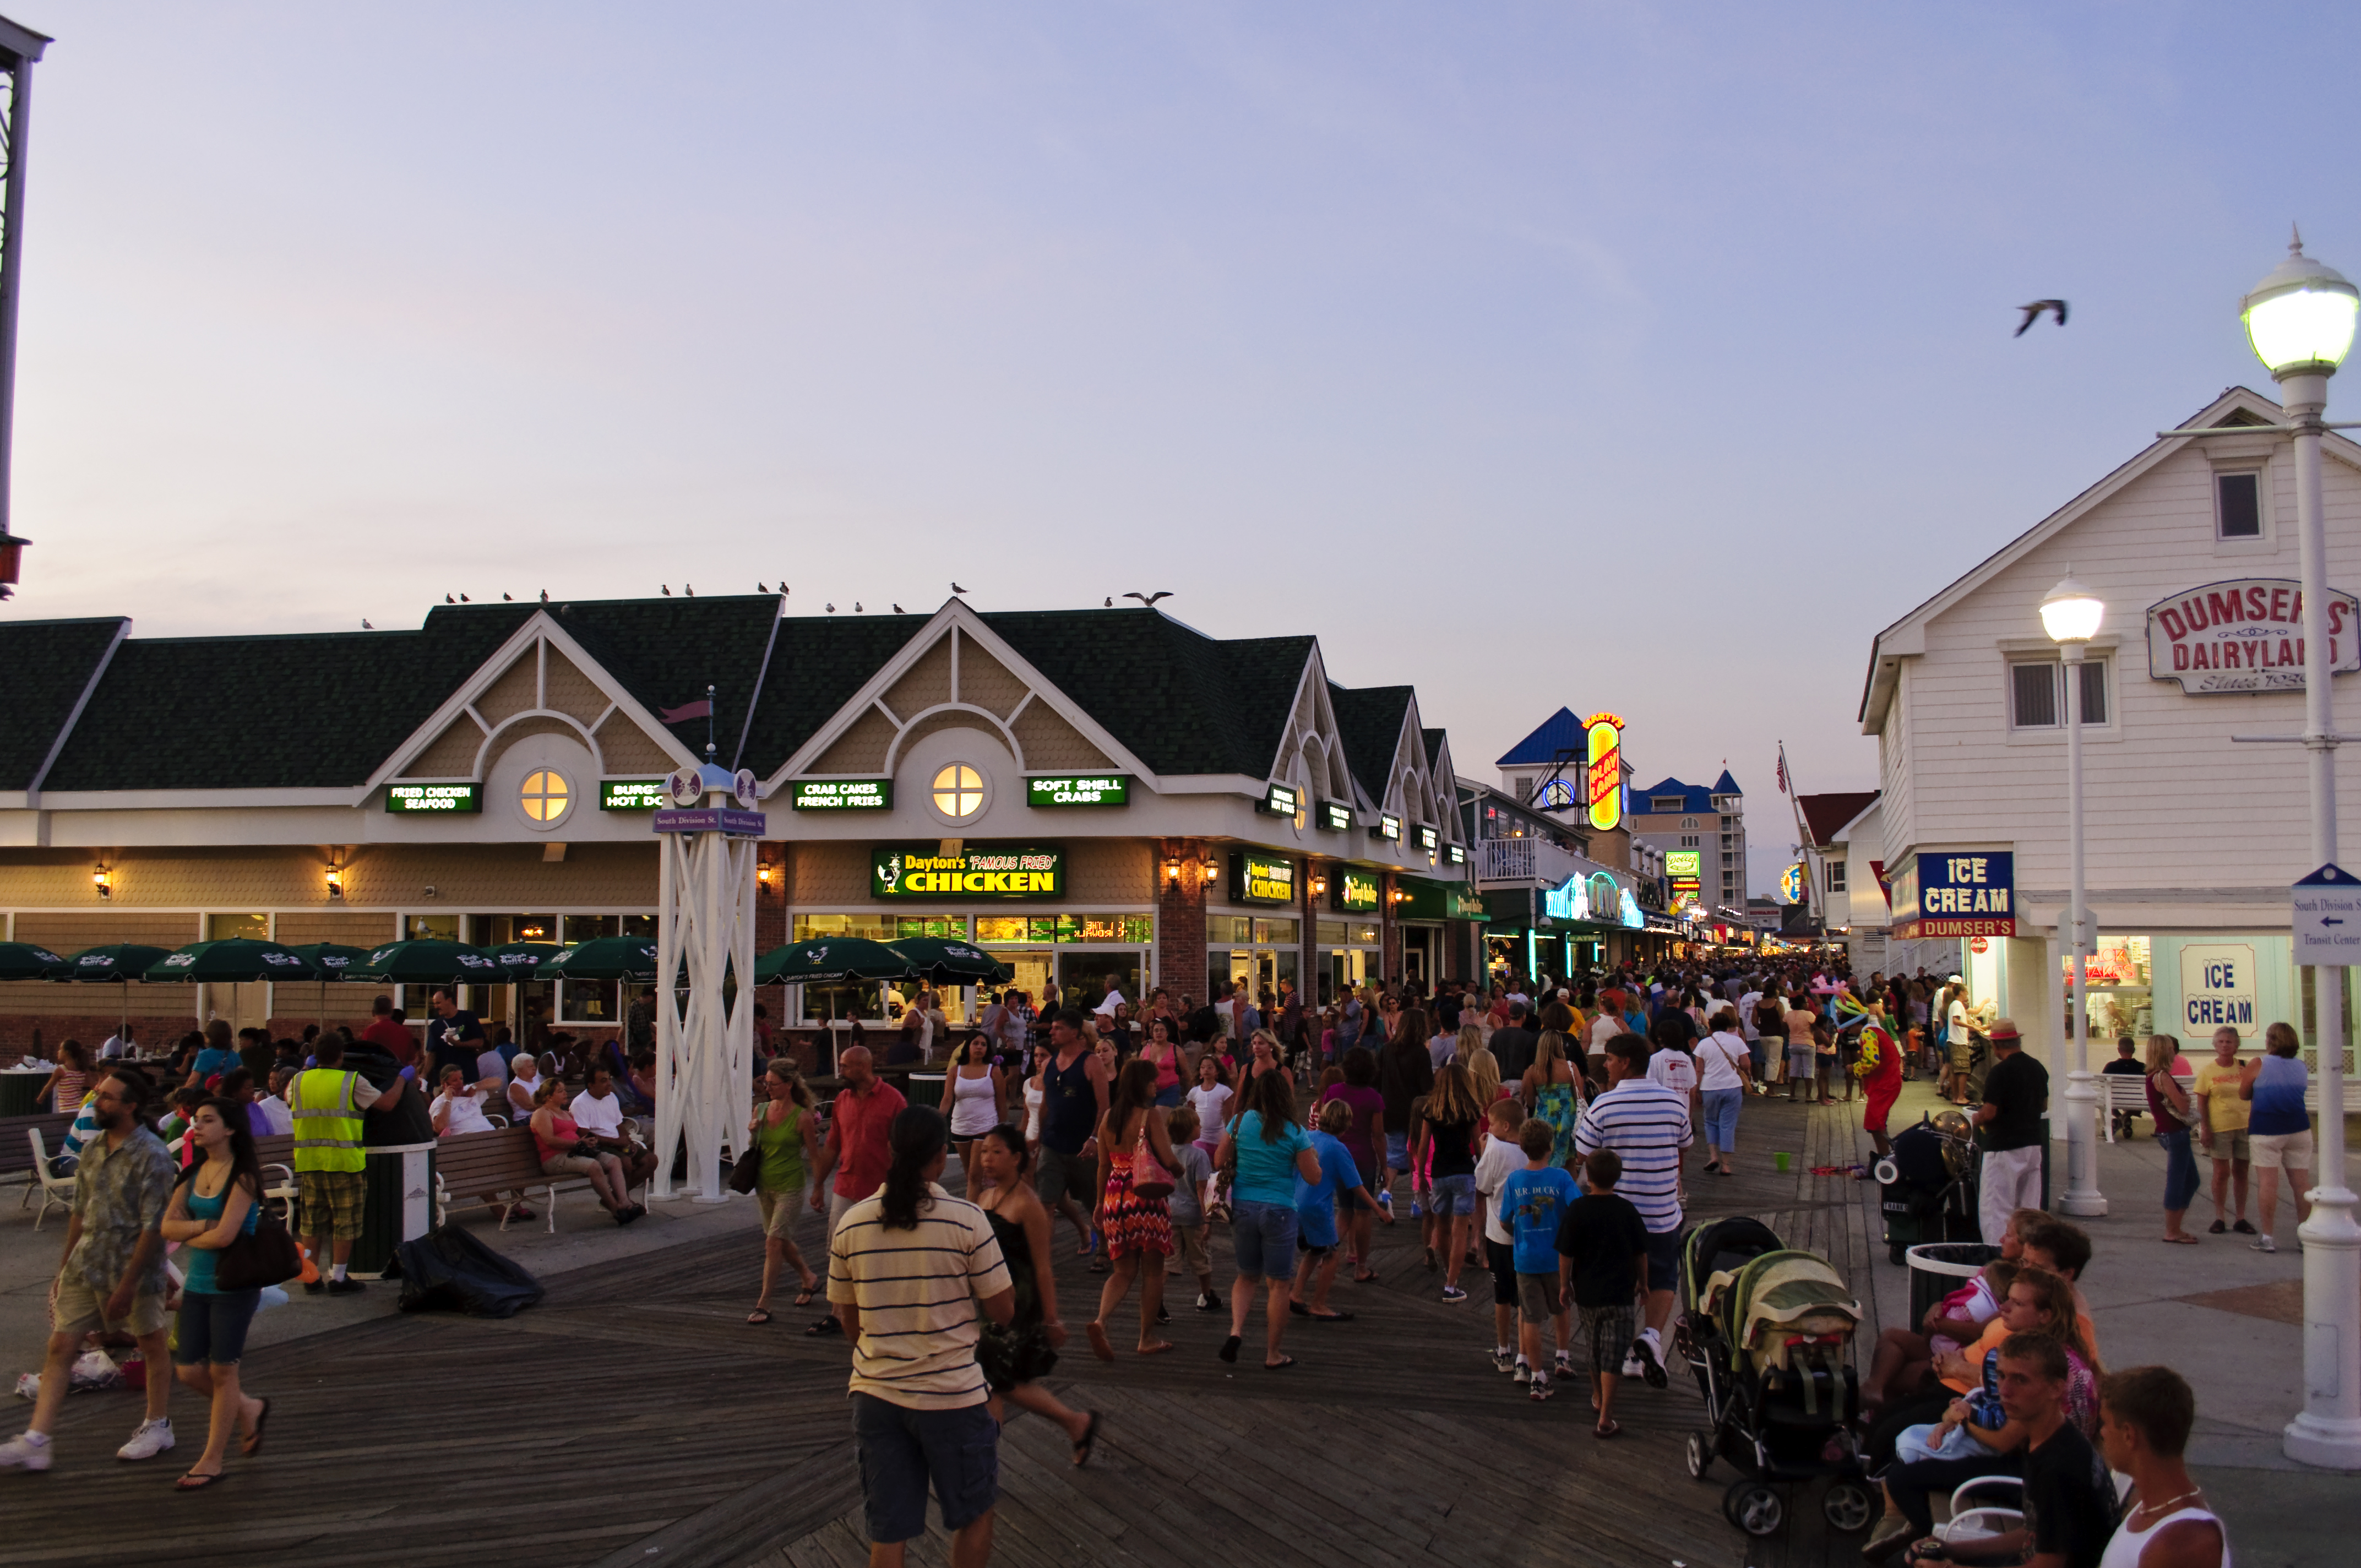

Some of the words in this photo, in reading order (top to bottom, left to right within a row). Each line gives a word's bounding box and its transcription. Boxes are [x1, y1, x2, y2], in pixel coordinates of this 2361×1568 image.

[2157, 587, 2348, 642] DUMSERS
[1591, 752, 1617, 784] PLAY
[391, 787, 424, 797] FRIED
[425, 787, 471, 797] CHICKEN
[804, 784, 837, 795] CRAB
[839, 783, 878, 794] CAKES
[1033, 780, 1071, 791] SOFT
[1076, 779, 1122, 791] SHELL
[1591, 770, 1618, 801] LAND
[405, 798, 456, 809] SEAFOOD
[606, 796, 638, 806] HOT
[643, 796, 663, 805] DO
[797, 796, 843, 807] FRENCH
[847, 796, 883, 806] FRIES
[1053, 791, 1101, 803] CRABS
[1271, 799, 1281, 810] HOT
[1281, 802, 1294, 814] DOGS
[723, 816, 737, 825] South
[738, 818, 757, 826] Division
[905, 855, 966, 872] Dayton's
[969, 856, 1018, 870] 'FAMOUS
[1019, 855, 1057, 870] FRIED'
[1251, 862, 1269, 879] Dayton's
[1947, 858, 1987, 883] ICE
[905, 873, 1054, 892] CHICKEN
[1252, 879, 1291, 900] CHICKEN
[1350, 882, 1363, 907] Dough
[1363, 883, 1377, 903] Roller
[1925, 888, 2008, 913] CREAM
[2294, 899, 2317, 911] South
[2320, 899, 2353, 911] Division
[2356, 898, 2361, 911] S
[1925, 921, 2011, 935] DUMSER'S
[2304, 933, 2331, 945] Transit
[2334, 933, 2360, 945] Center
[2067, 964, 2135, 978] SAKES
[2202, 957, 2234, 988] ICE
[2187, 993, 2252, 1024] CREAM
[1514, 1187, 1531, 1200] M.R.
[1532, 1186, 1560, 1197] DUCKS
[1884, 1202, 1908, 1212] THANKS
